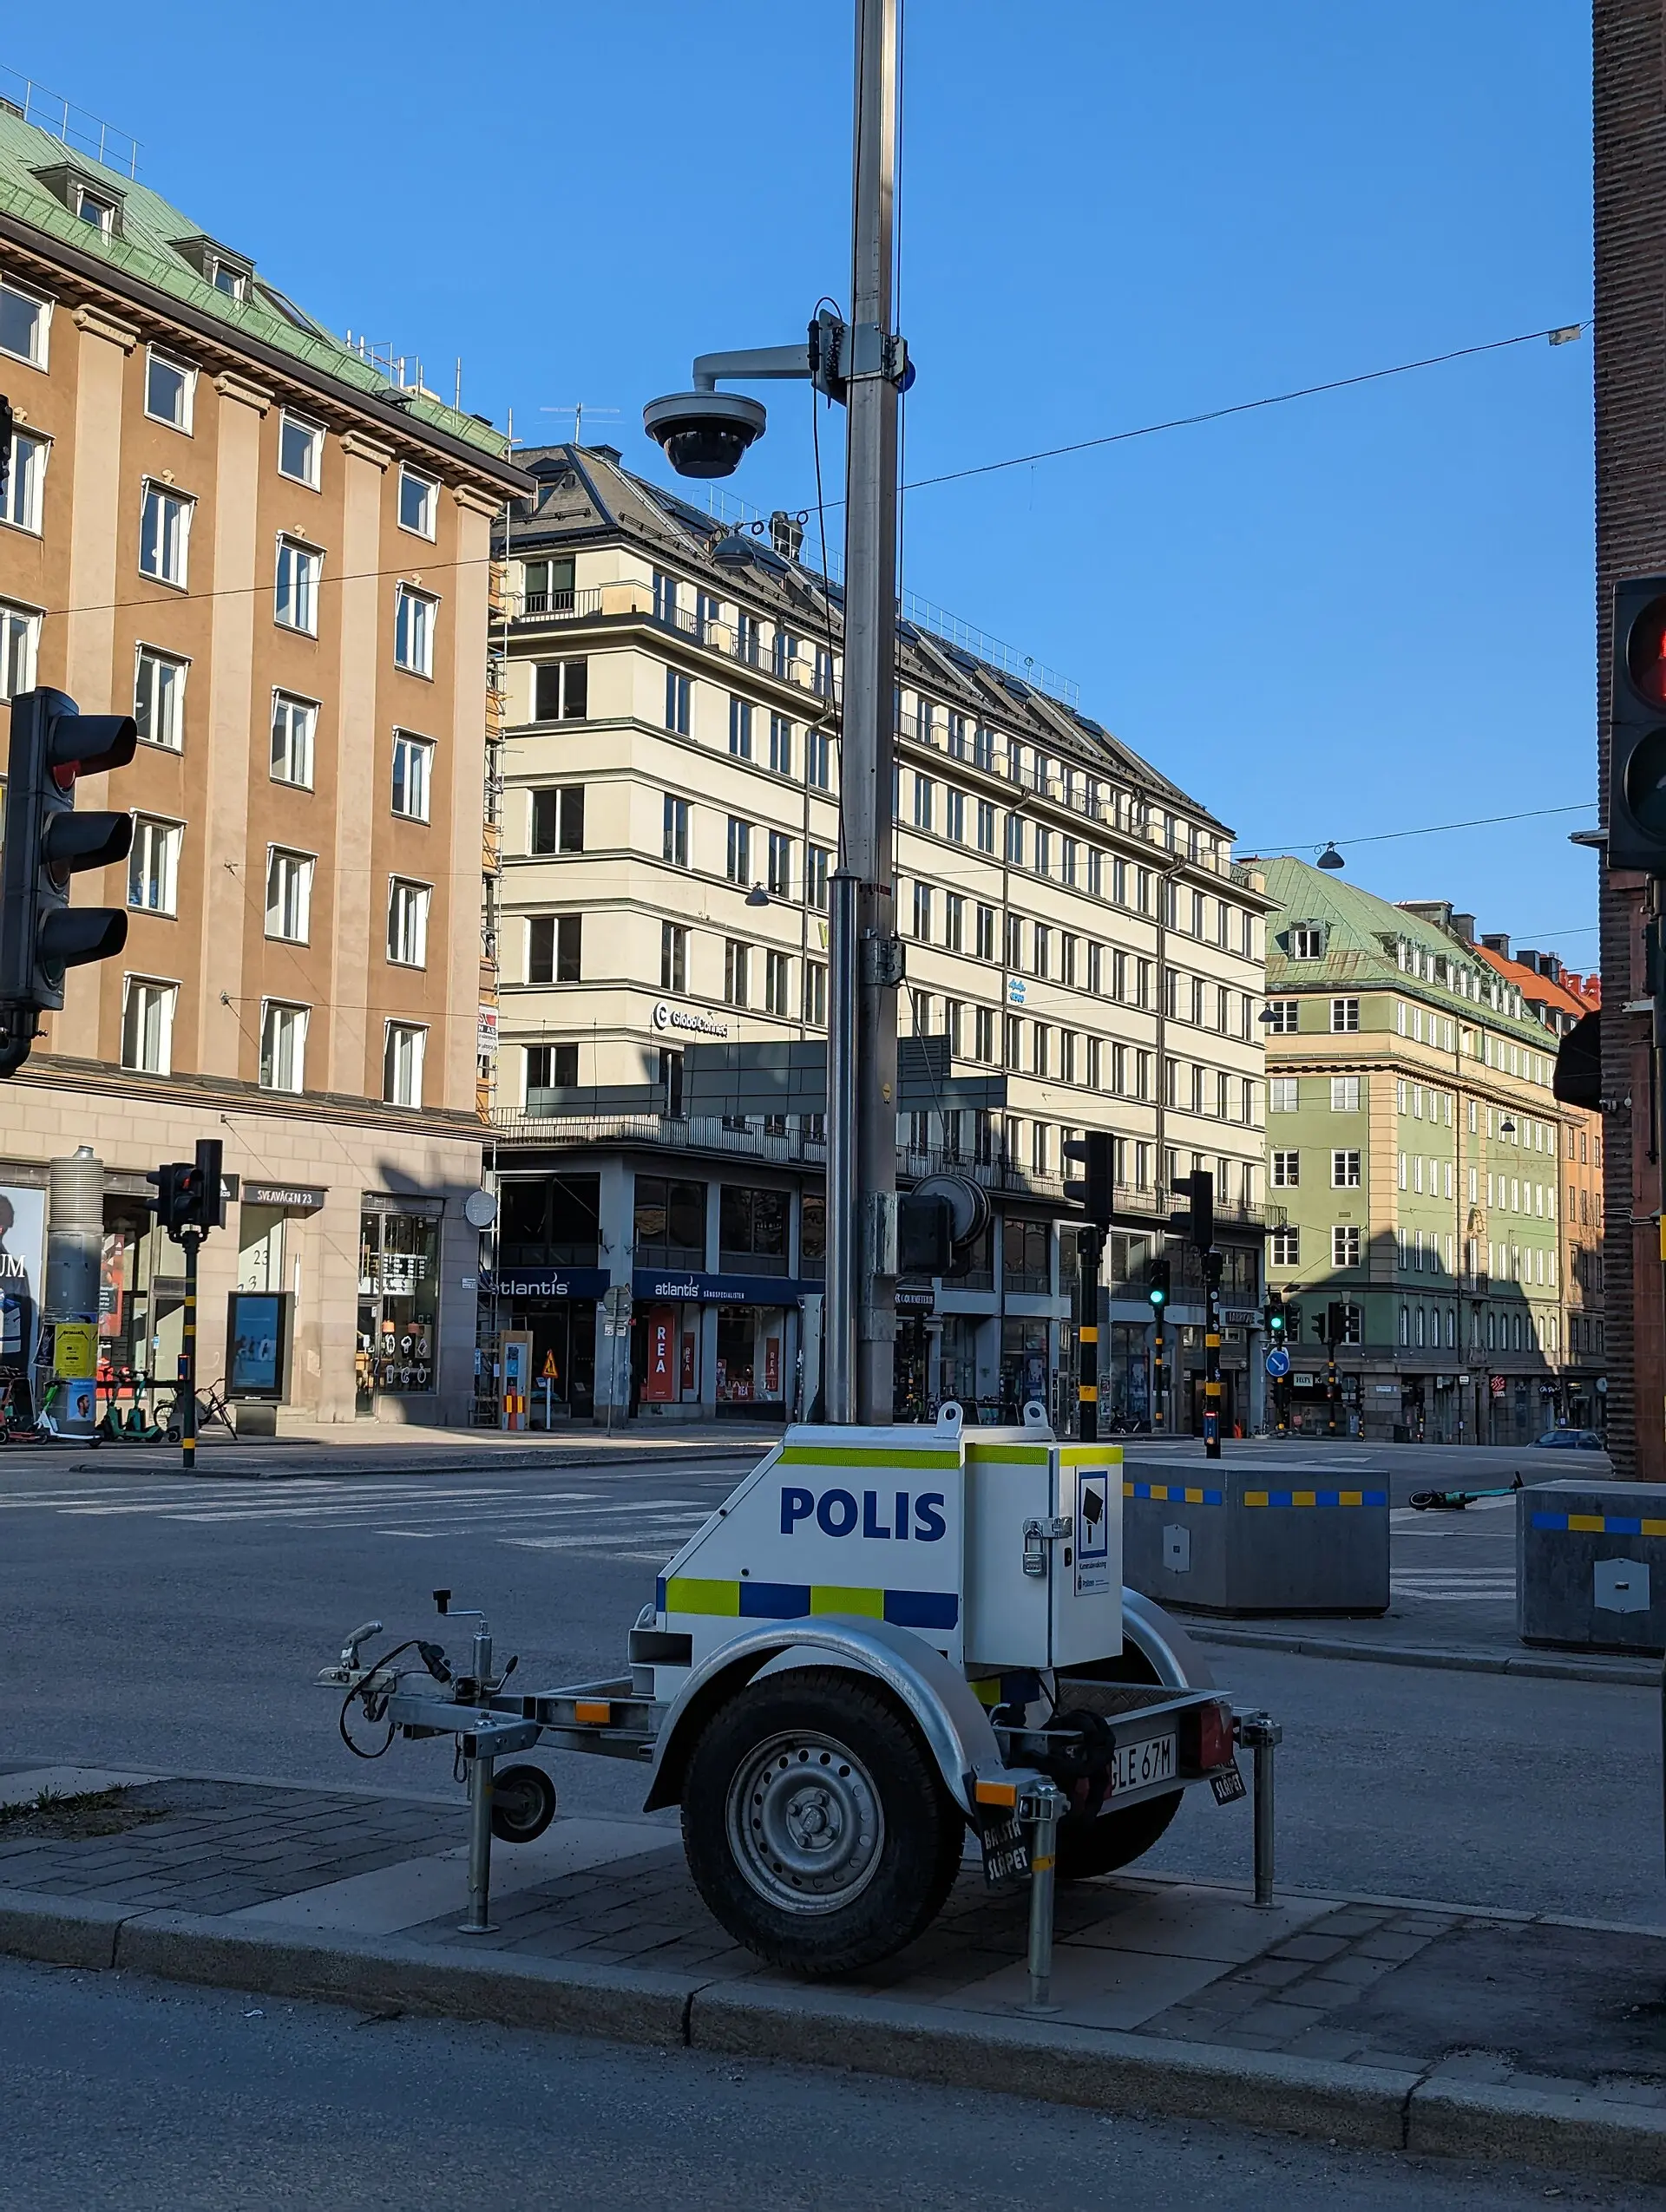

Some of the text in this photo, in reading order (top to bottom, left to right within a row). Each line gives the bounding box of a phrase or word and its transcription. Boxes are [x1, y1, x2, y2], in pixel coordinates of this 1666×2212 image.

[257, 1189, 312, 1204] SVEAVÄGEN 23
[254, 1250, 268, 1266] 23
[655, 1275, 699, 1297] atlantis
[656, 1326, 666, 1373] REA
[780, 1487, 947, 1542] POLIS
[1141, 1738, 1171, 1781] 67M
[1215, 1773, 1243, 1799] SLÄPET
[987, 1845, 1028, 1881] SLÄPET
